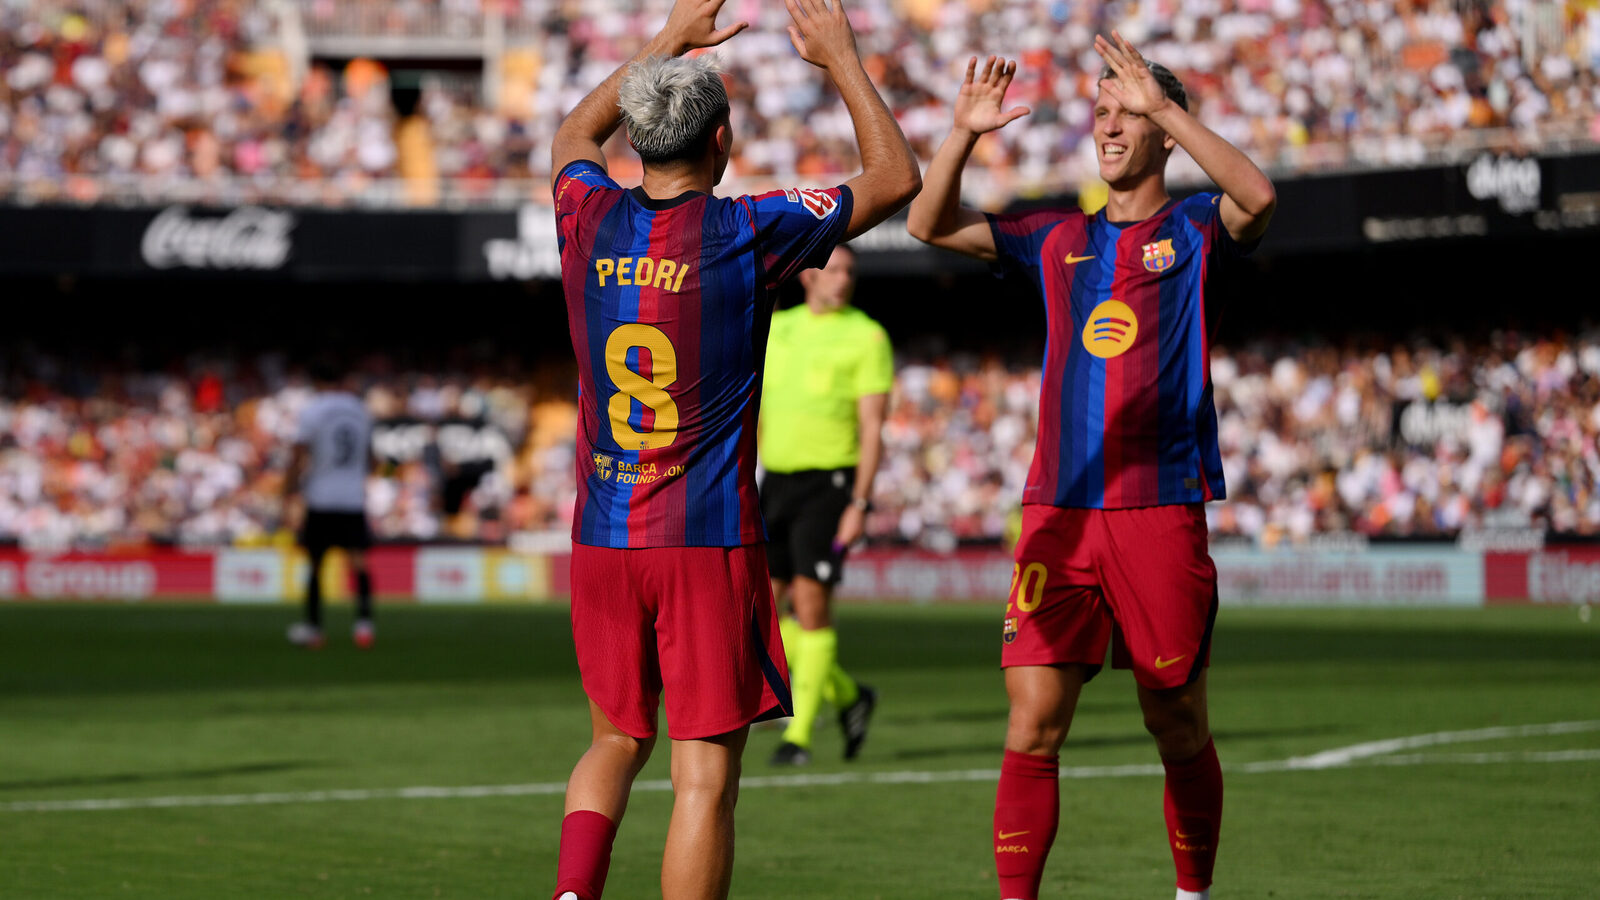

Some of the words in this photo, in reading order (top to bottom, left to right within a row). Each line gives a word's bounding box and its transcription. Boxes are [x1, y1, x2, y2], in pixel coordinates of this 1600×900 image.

[596, 257, 689, 293] PEDRI
[605, 323, 679, 450] 8
[617, 461, 657, 475] BARÇA
